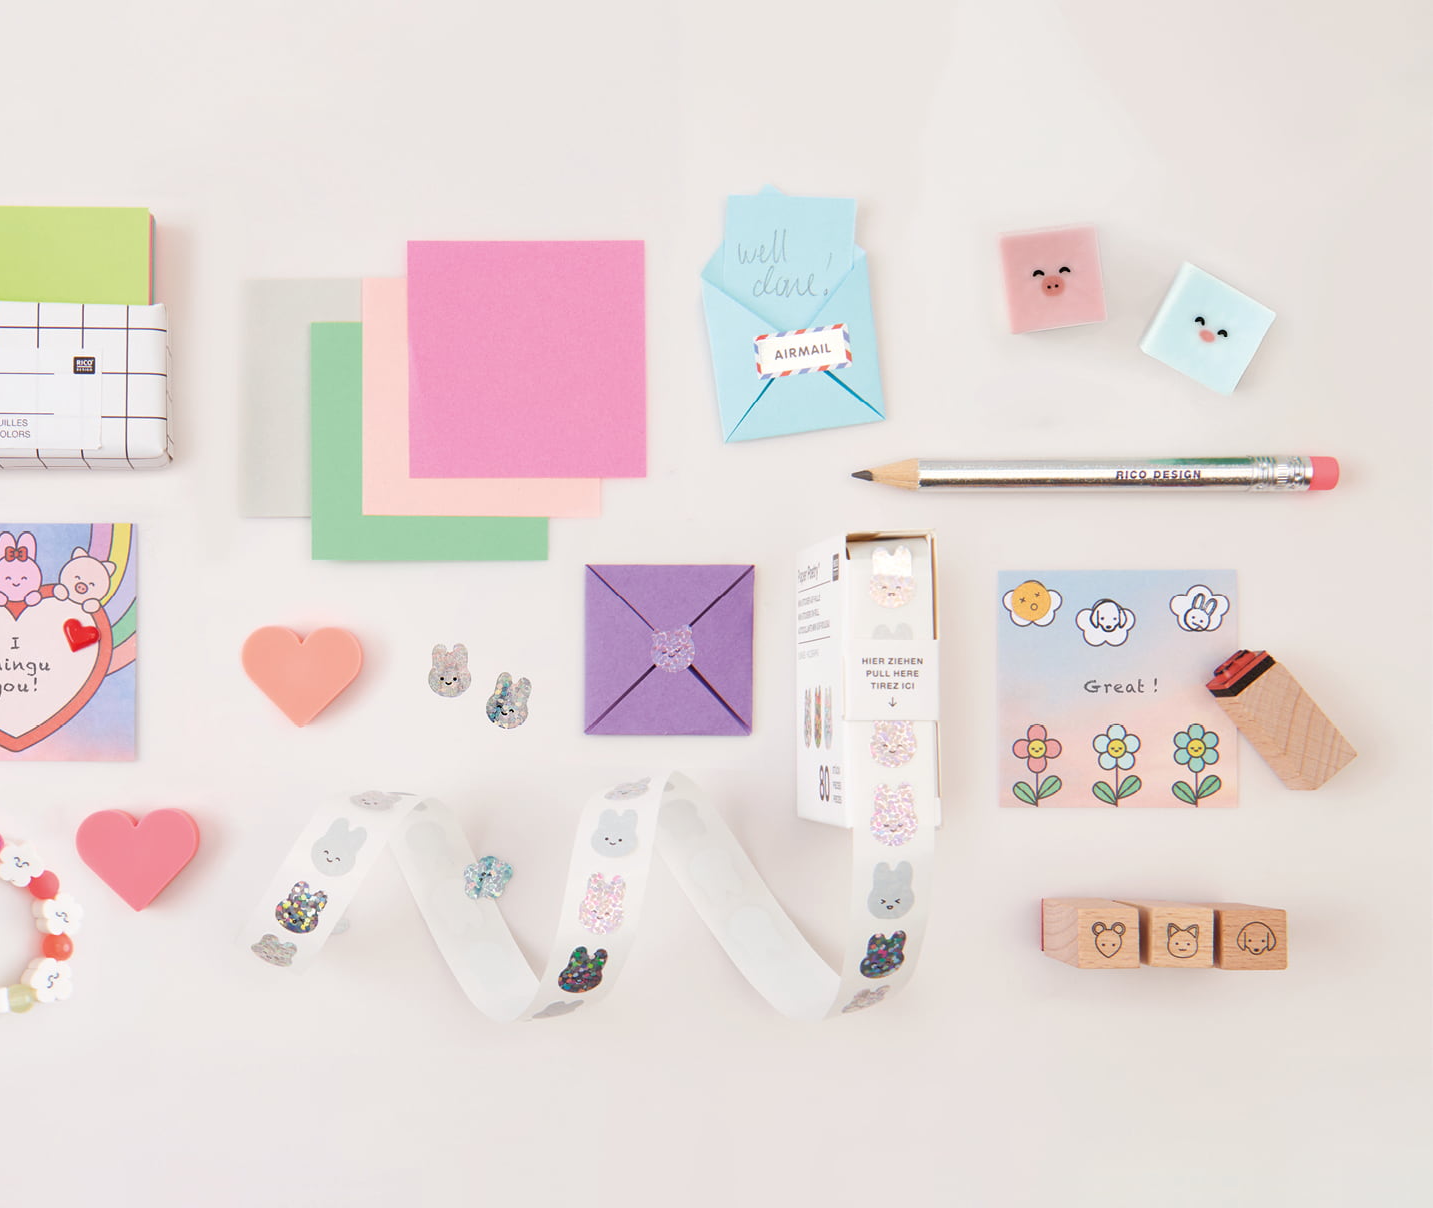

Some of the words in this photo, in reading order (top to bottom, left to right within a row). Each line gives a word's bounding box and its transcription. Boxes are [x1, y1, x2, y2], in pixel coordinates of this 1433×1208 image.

[737, 228, 787, 264] well
[774, 343, 832, 361] AIRMAIL
[1115, 470, 1147, 480] RICO
[1153, 470, 1201, 479] DESIGN
[10, 637, 19, 649] I
[861, 657, 885, 665] HIER
[887, 657, 923, 665] ZIEHEN
[870, 682, 899, 690] TIREZ
[901, 682, 915, 690] ICI
[819, 764, 830, 802] 80
